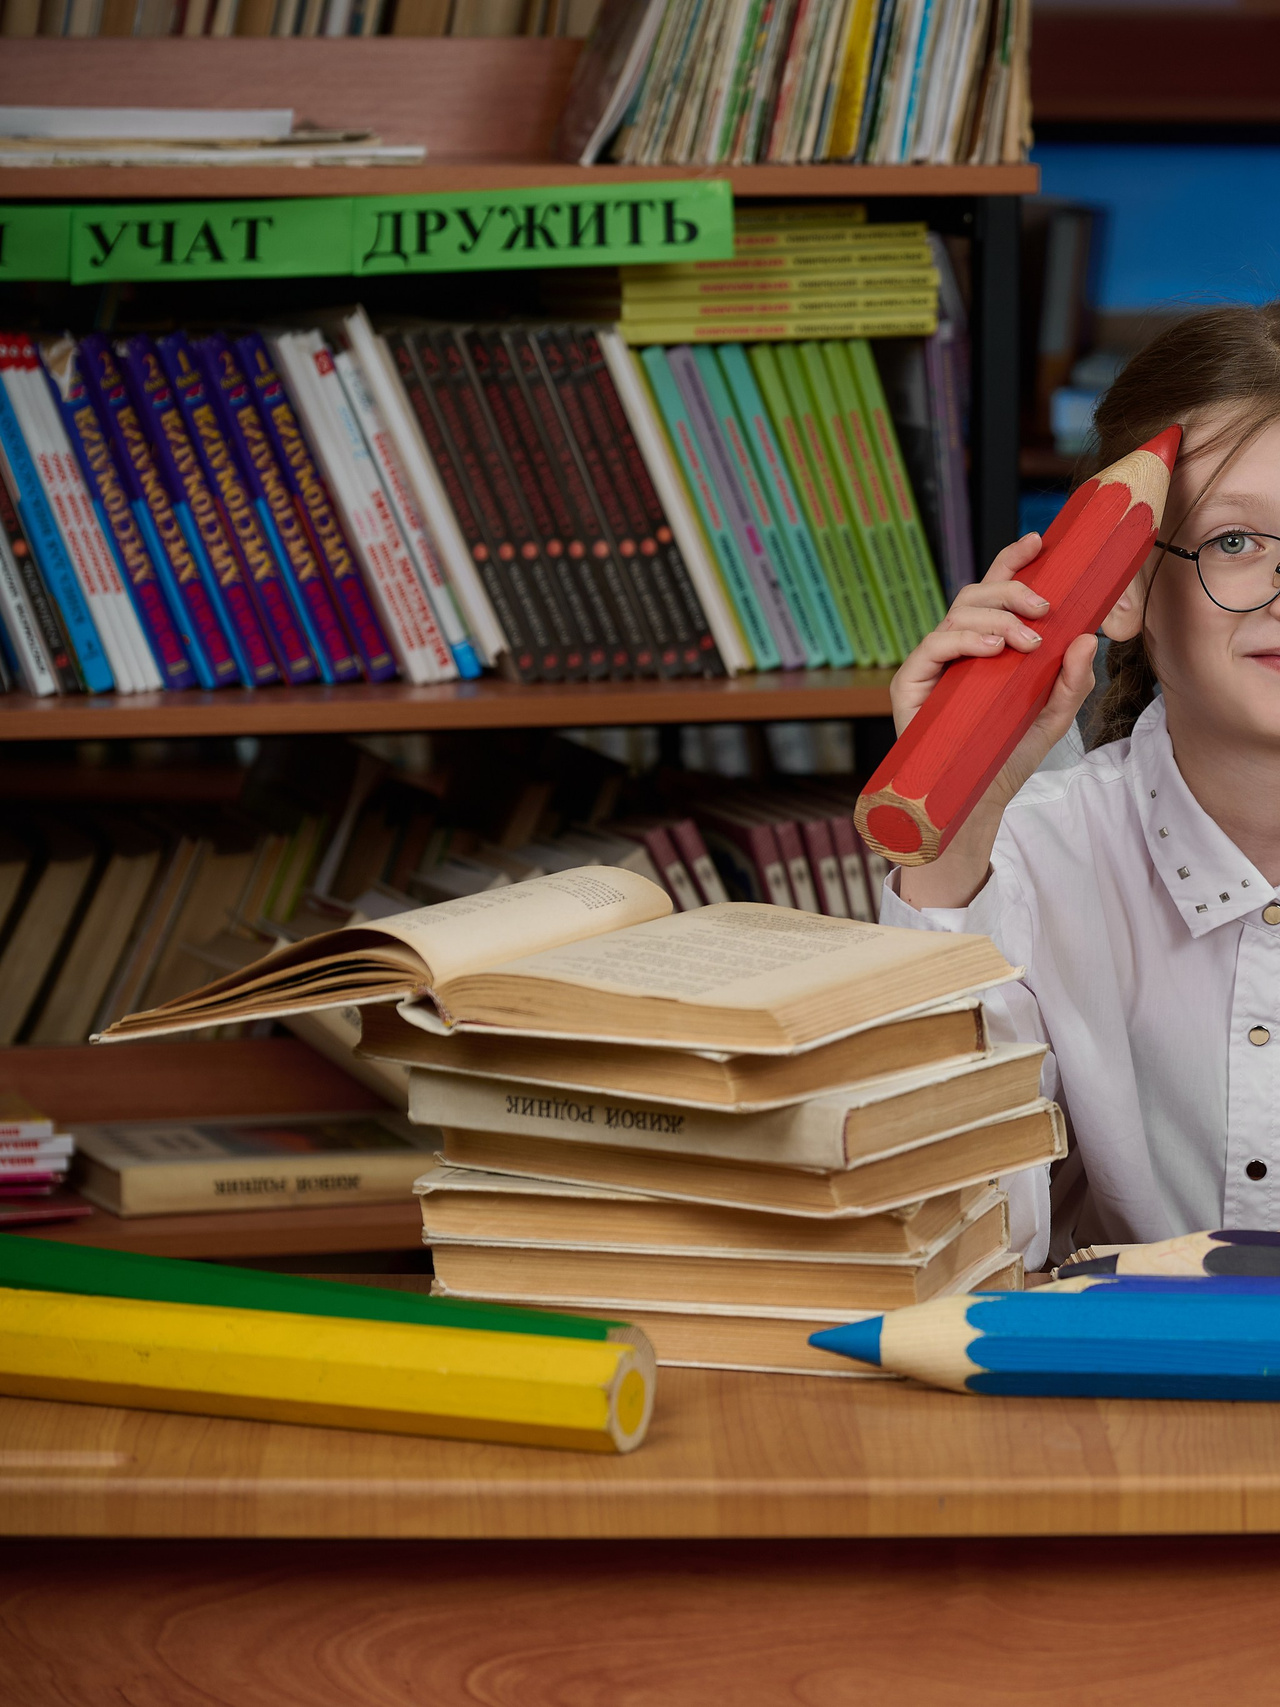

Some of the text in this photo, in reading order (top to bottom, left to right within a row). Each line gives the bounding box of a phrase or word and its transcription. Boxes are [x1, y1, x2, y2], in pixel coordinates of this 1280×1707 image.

[87, 199, 700, 268] УЧАТ ДРУЖИТЬ
[505, 1096, 684, 1135] ЖИВОЙ РОДНИК
